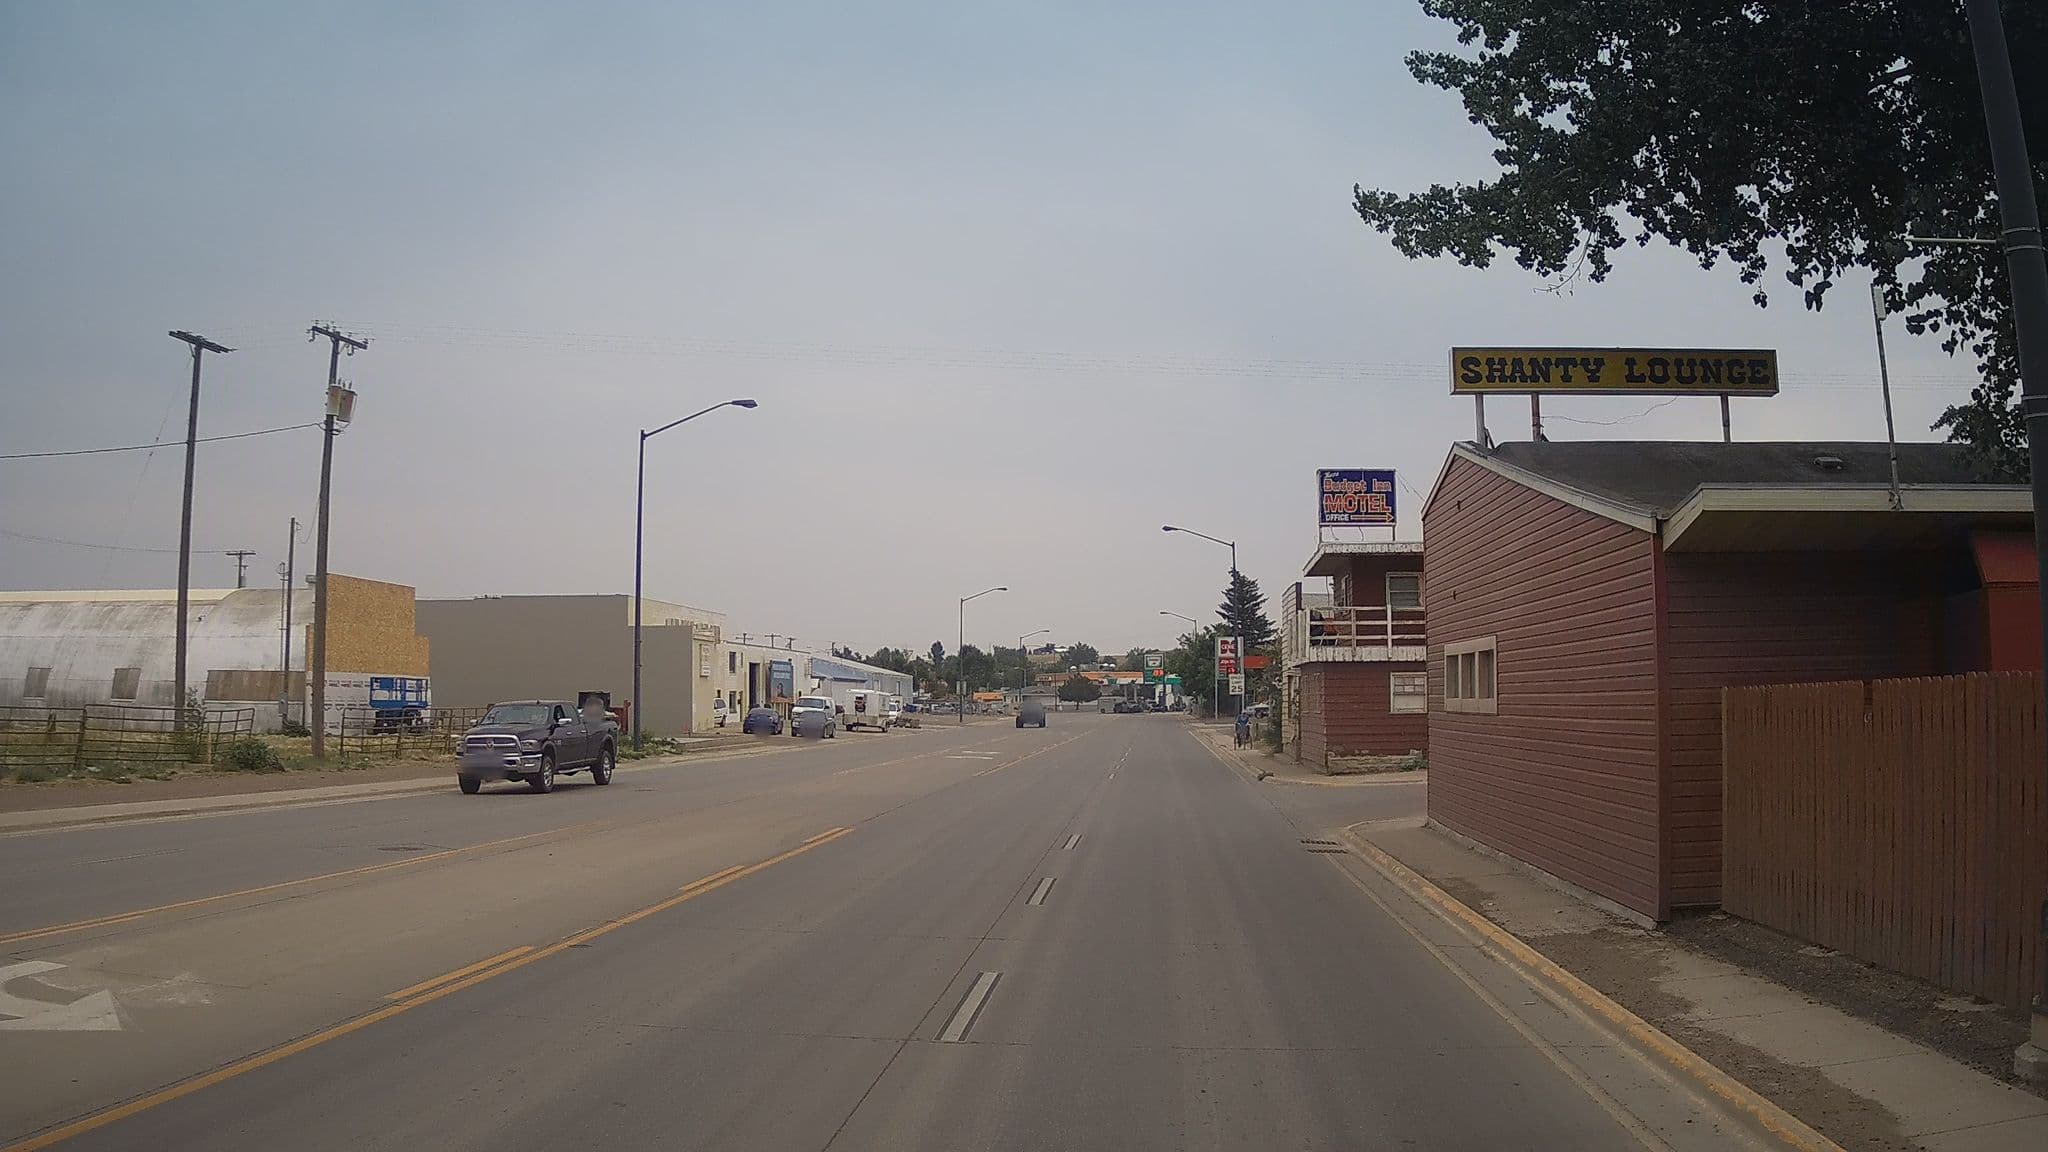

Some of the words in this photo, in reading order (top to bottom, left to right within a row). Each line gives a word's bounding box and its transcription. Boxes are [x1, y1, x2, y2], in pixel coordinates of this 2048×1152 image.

[1460, 356, 1606, 385] SHANTY
[1624, 357, 1770, 385] LOUNGE
[1324, 478, 1367, 493] Budget
[1372, 478, 1392, 492] Inn
[1323, 493, 1392, 513] MOTEL
